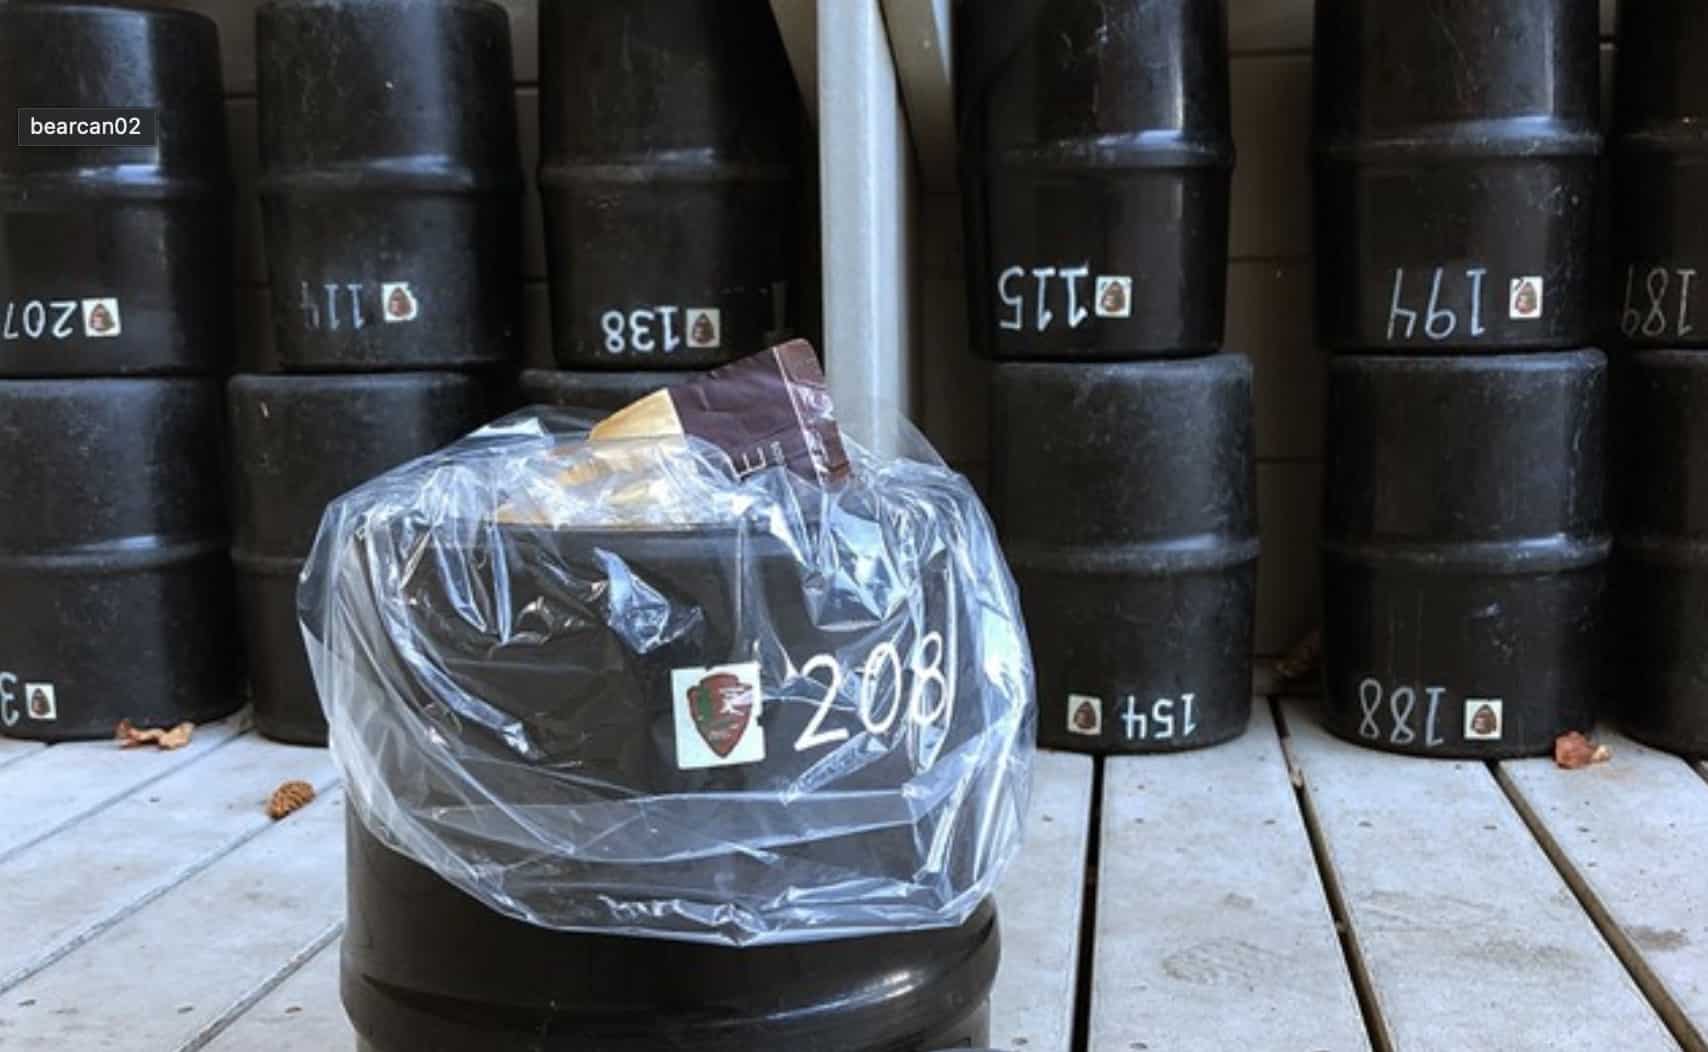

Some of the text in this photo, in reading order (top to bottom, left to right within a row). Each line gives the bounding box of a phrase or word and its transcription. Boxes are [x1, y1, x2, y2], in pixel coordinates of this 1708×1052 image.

[3, 299, 78, 340] 207
[301, 281, 365, 329] 114
[602, 306, 680, 353] 138
[998, 265, 1088, 331] 115
[1387, 267, 1487, 340] 194
[1620, 265, 1698, 338] 189
[794, 631, 948, 751] 208
[1122, 692, 1197, 740] 154
[1359, 678, 1446, 747] 188
